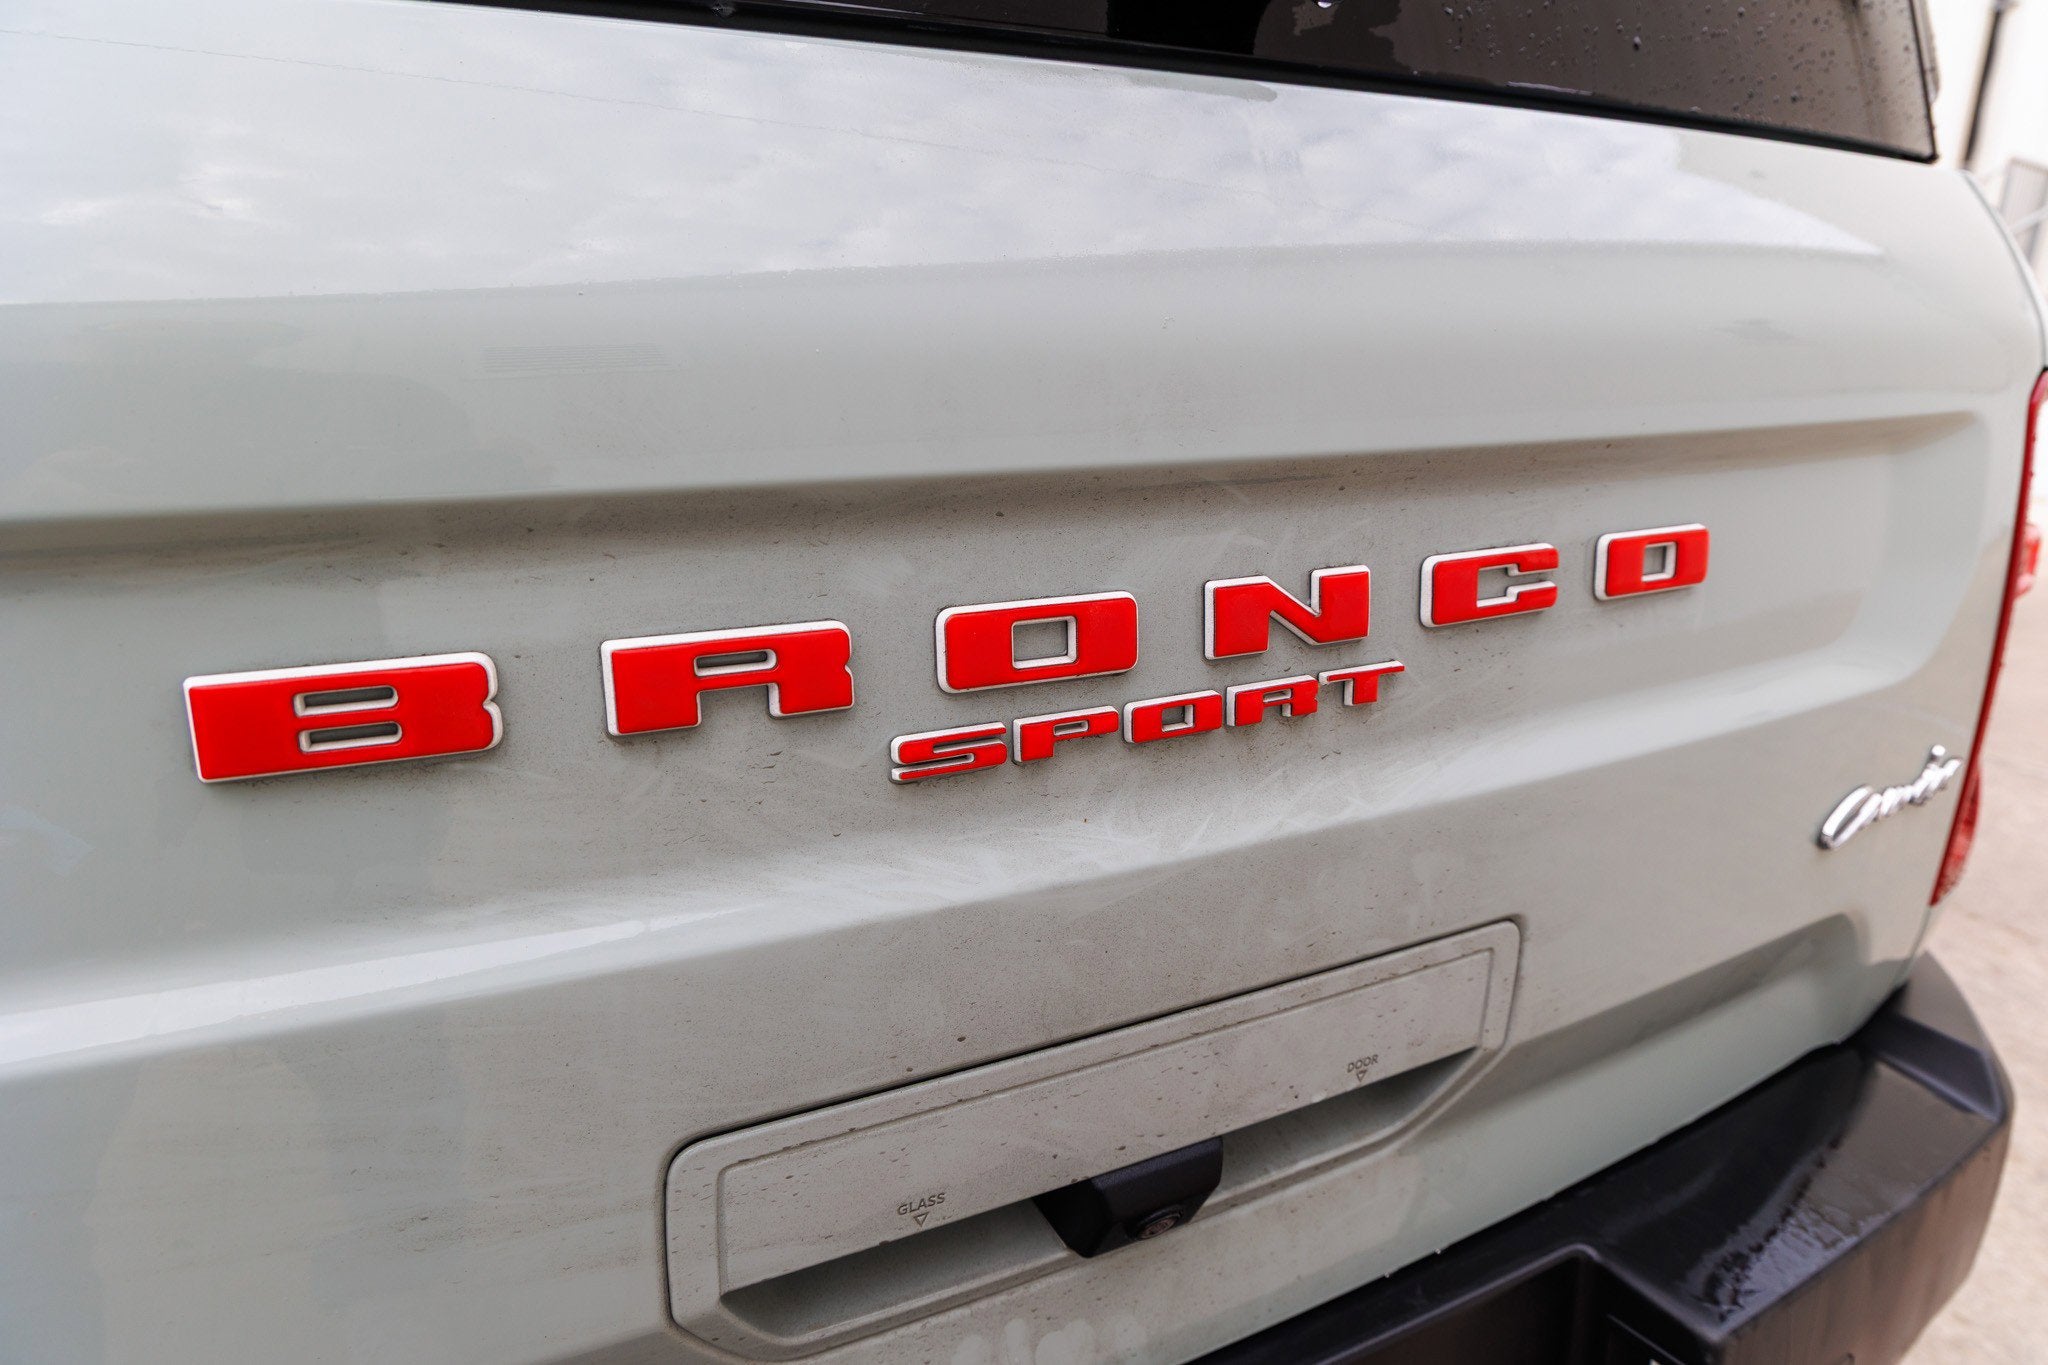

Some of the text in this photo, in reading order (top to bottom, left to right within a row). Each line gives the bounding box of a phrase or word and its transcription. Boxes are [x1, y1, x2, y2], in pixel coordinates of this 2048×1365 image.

[182, 523, 1711, 784] BRONCO
[890, 659, 1406, 784] SPORT
[1346, 1053, 1379, 1074] DOOR
[896, 1192, 946, 1216] GLASS
